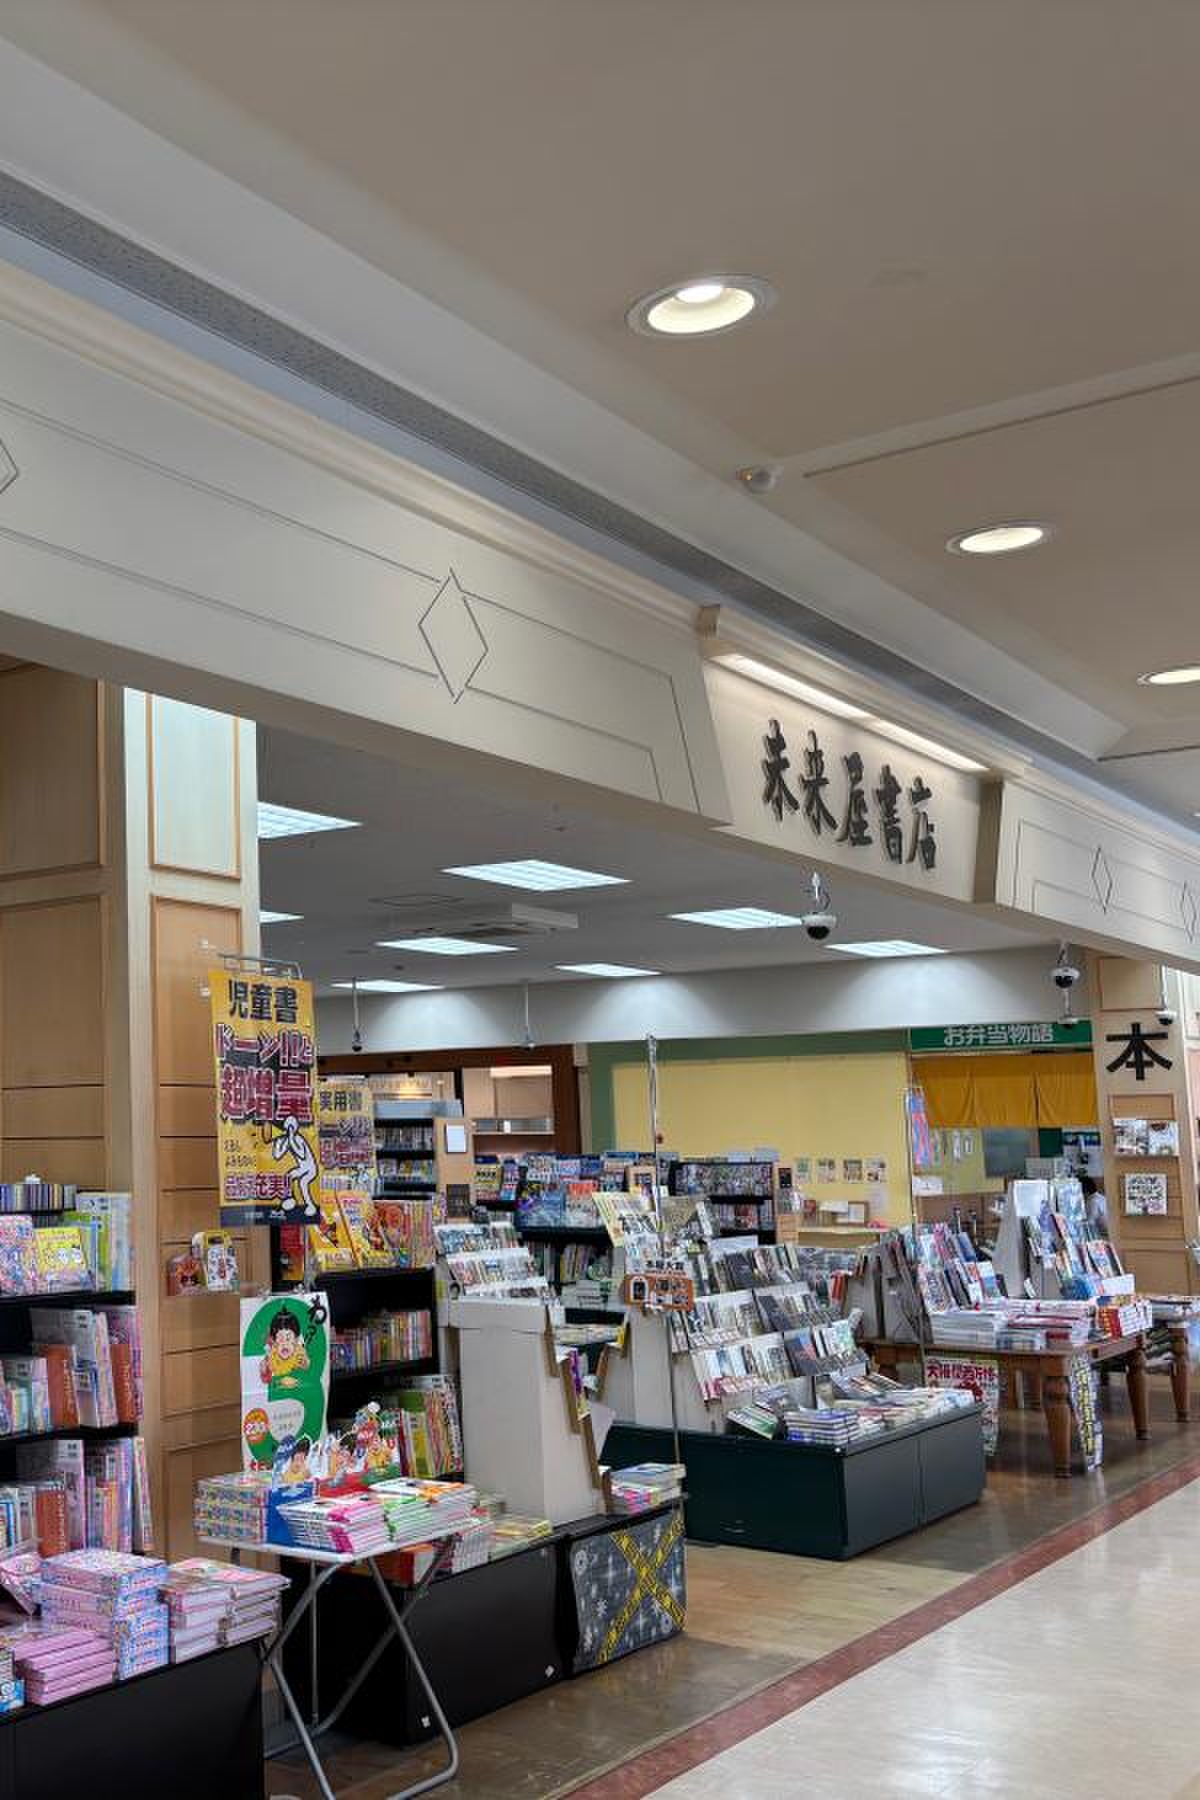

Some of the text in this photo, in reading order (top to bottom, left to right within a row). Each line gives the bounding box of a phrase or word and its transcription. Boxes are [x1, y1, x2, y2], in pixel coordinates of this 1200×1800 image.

[762, 718, 938, 871] 未来屋書店
[228, 979, 298, 1024] 児童書
[943, 1023, 1054, 1046] お弁当物語
[1106, 1022, 1173, 1081] 本
